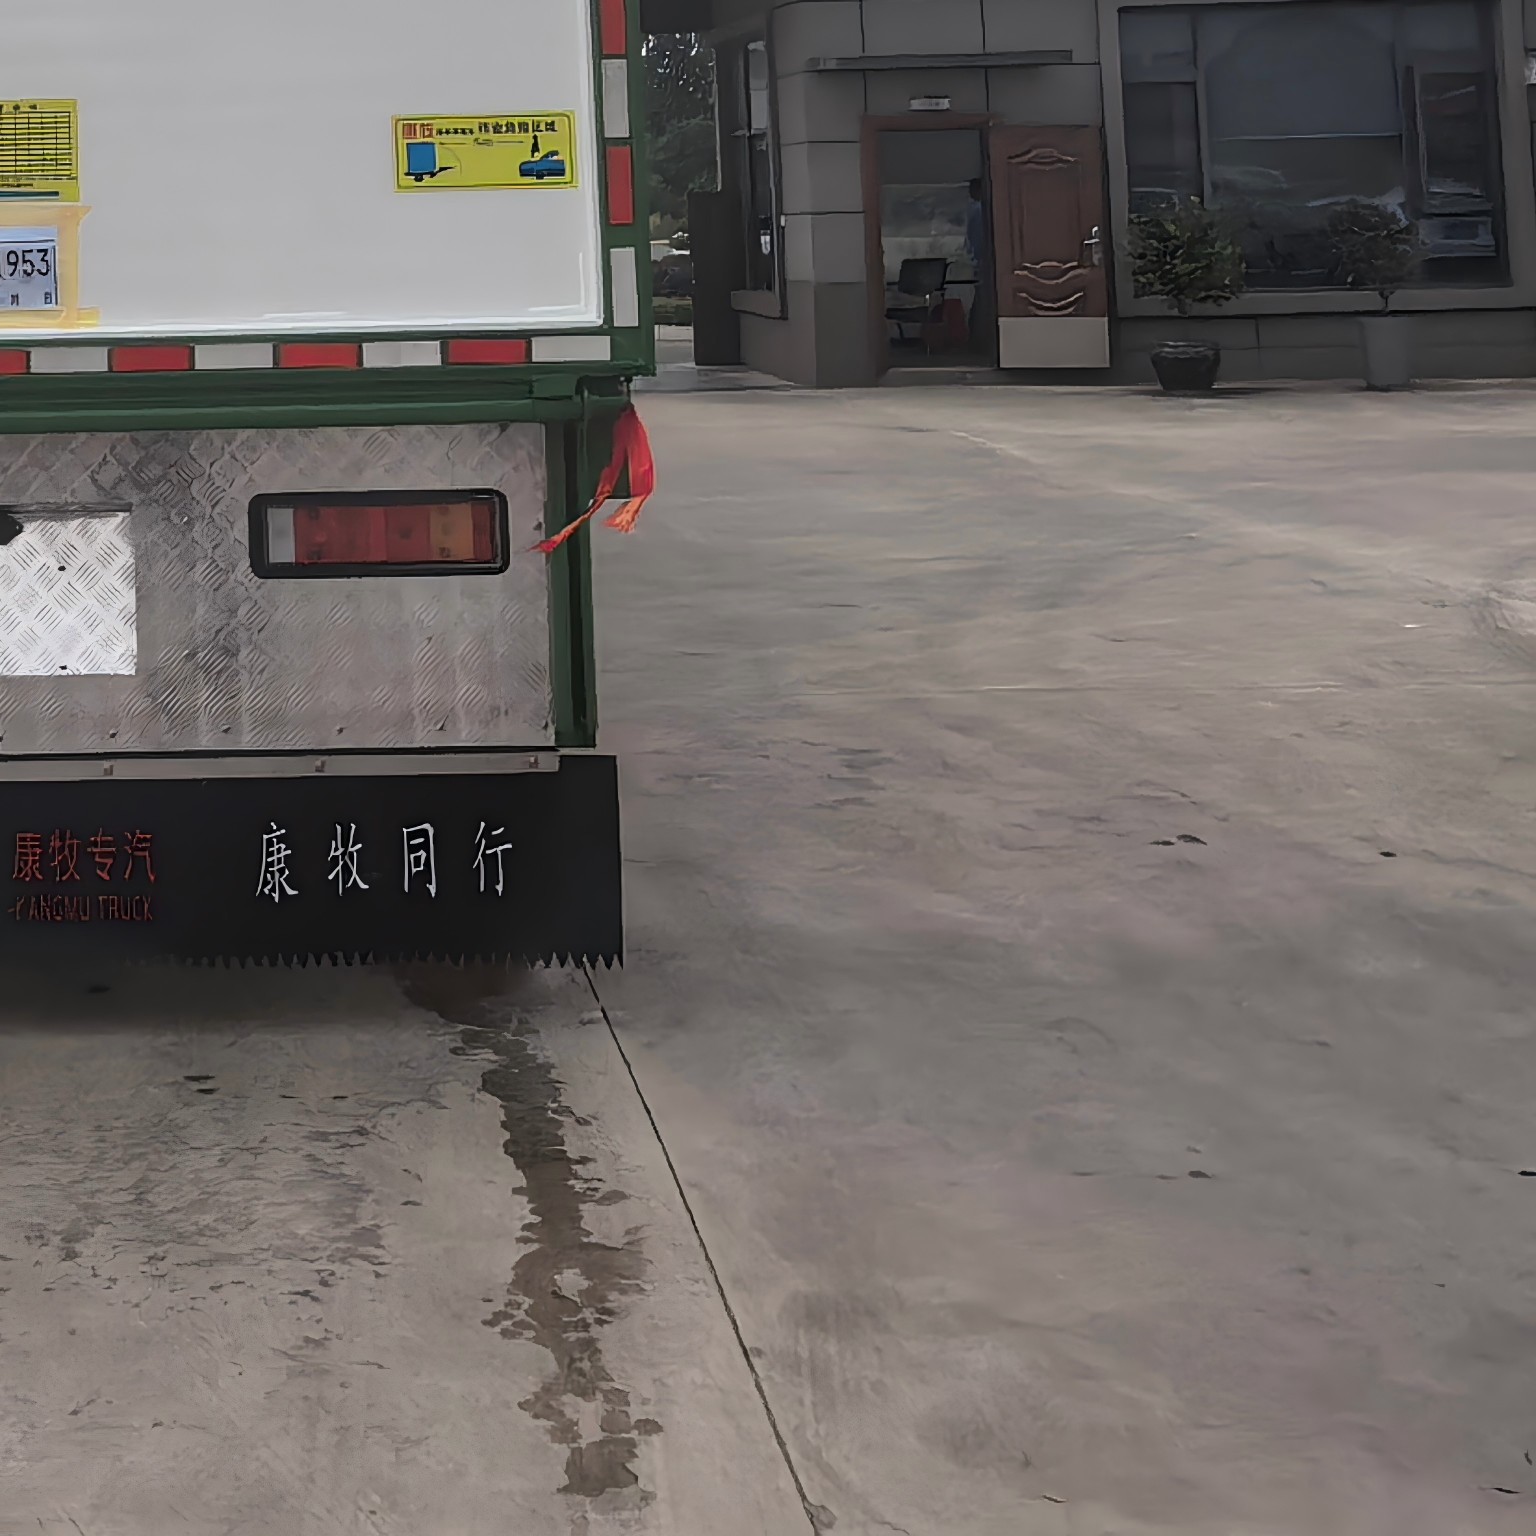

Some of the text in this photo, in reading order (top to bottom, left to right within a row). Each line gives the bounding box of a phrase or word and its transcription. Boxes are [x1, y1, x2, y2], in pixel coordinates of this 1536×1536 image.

[13, 827, 156, 883] 康牧专汽
[255, 820, 514, 904] 康牧同行
[98, 895, 153, 921] TRUCK
